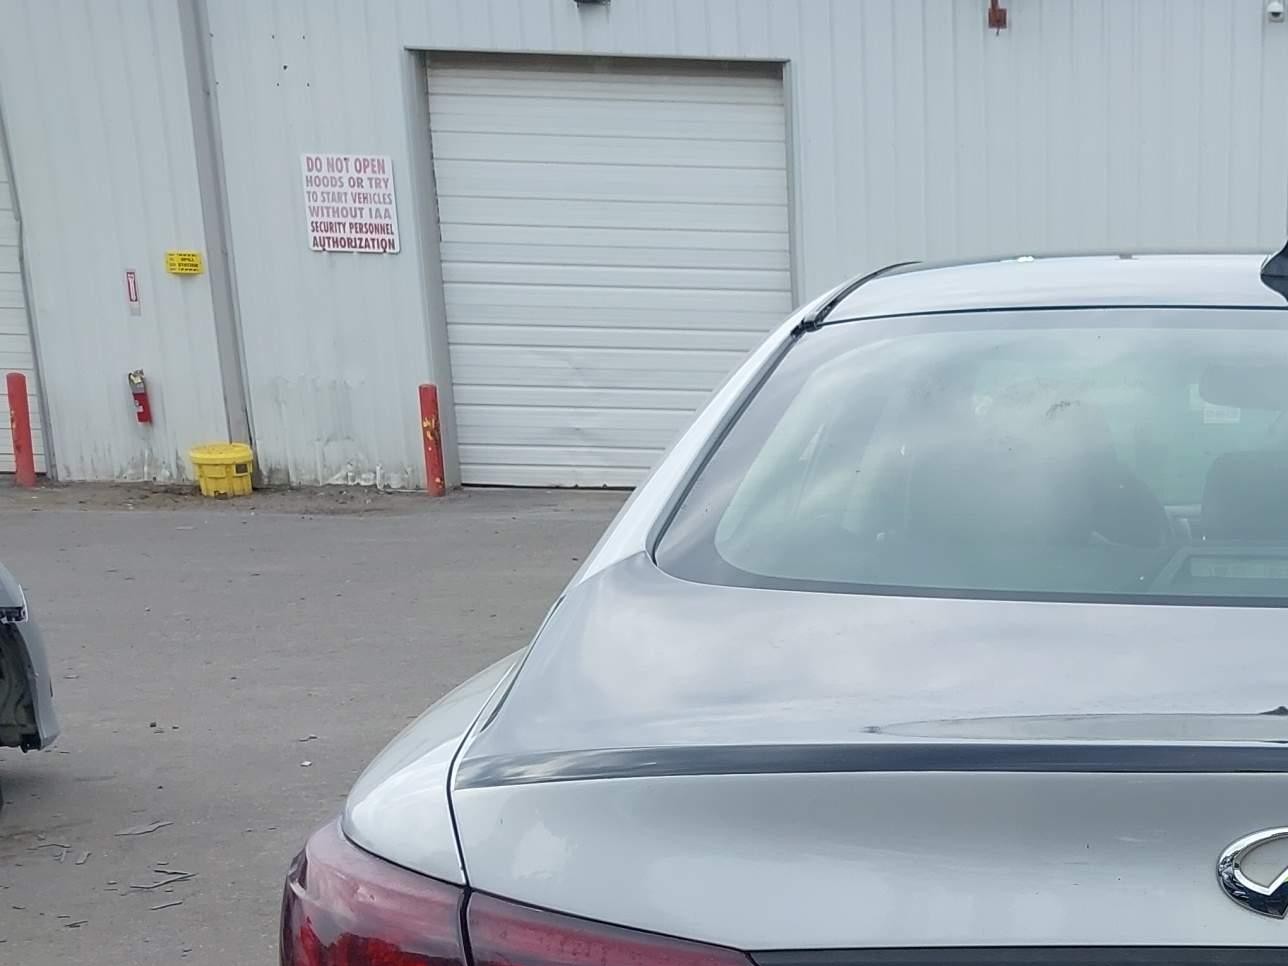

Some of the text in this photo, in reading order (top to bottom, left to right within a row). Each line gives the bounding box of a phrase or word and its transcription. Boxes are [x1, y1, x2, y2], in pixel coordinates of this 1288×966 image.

[306, 156, 385, 174] DO NOT OPEN
[306, 175, 390, 190] HOODS OR TRY
[306, 191, 393, 205] TO START VEHICLES
[308, 205, 392, 220] WITHOUT IAA
[310, 220, 394, 235] SECURITY PERSONNEL
[312, 236, 396, 250] AUTHORIZATION
